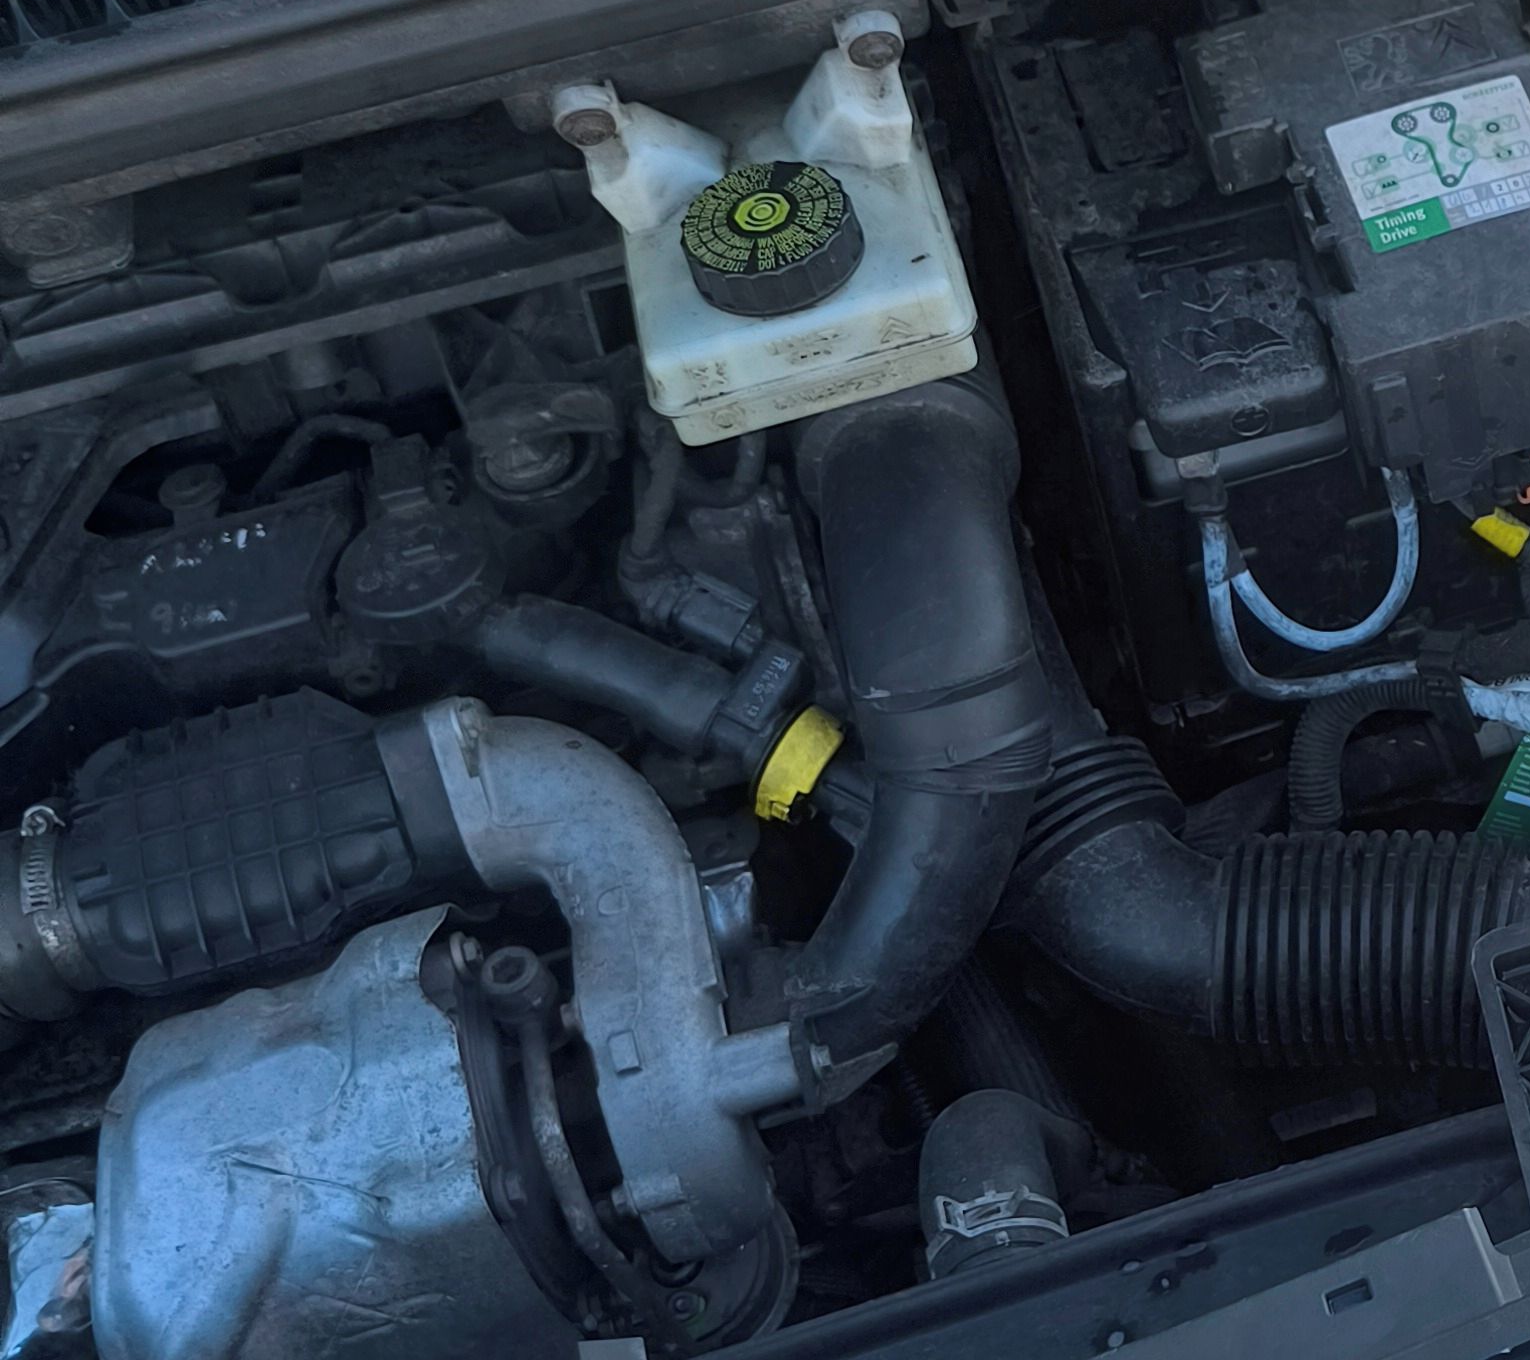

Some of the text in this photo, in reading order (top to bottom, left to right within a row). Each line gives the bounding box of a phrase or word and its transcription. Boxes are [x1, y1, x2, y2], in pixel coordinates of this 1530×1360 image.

[1375, 207, 1426, 231] Timing
[757, 246, 775, 260] CAP
[778, 230, 813, 253] BEFORE
[1380, 226, 1418, 245] Drive
[758, 259, 775, 271] DOT
[787, 244, 813, 262] FLUID
